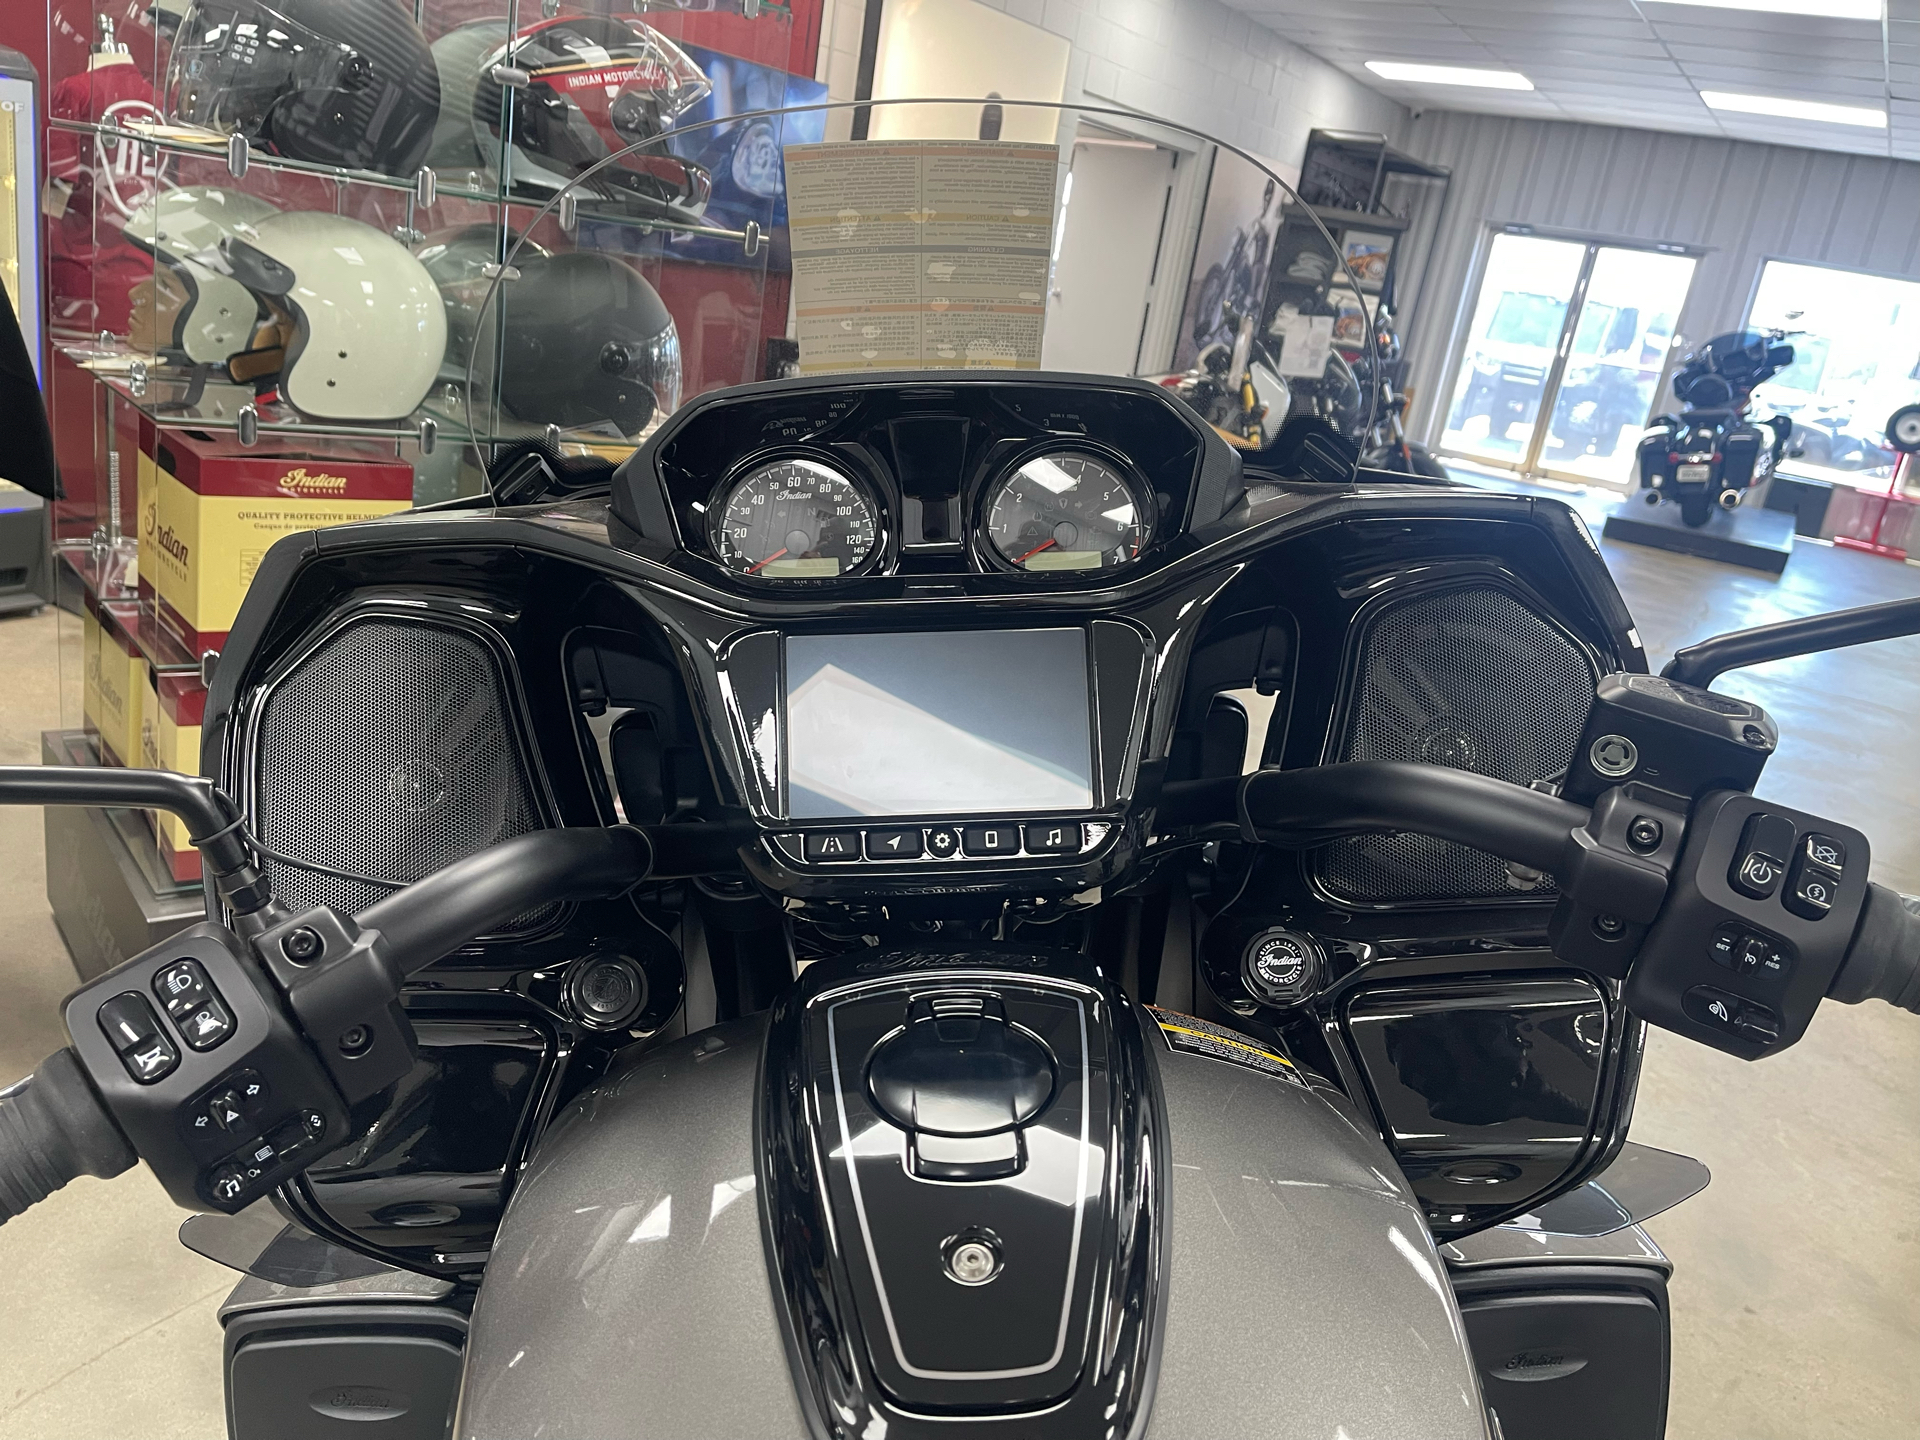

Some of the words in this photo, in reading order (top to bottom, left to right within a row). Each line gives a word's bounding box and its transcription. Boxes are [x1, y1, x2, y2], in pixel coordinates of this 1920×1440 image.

[568, 73, 602, 88] INDIAN
[603, 69, 660, 85] MOTORCY
[1, 101, 24, 113] OF
[279, 468, 347, 488] Indian
[787, 477, 801, 487] 60
[806, 477, 816, 485] 70
[281, 486, 345, 495] MOTORCYCLE
[769, 482, 780, 490] 50
[819, 483, 832, 493] 80
[751, 494, 765, 505] 40
[776, 489, 813, 501] Indian
[833, 494, 842, 502] 90
[1016, 493, 1023, 503] 2
[1103, 492, 1110, 501] 5
[238, 511, 281, 520] QUALITY
[283, 512, 343, 521] PROTECTIVE
[741, 507, 751, 515] 30
[836, 506, 852, 516] 100
[1003, 524, 1008, 533] 1
[1117, 522, 1124, 532] 6
[144, 502, 190, 566] Indian
[734, 528, 748, 539] 20
[846, 535, 862, 545] 120
[734, 550, 743, 559] 10
[853, 546, 865, 554] 140
[1113, 556, 1119, 565] 7
[1259, 940, 1281, 956] SINCE
[1284, 941, 1300, 954] 1901
[1715, 942, 1731, 952] SET
[1257, 953, 1303, 967] Indian
[1764, 960, 1780, 970] RES
[1259, 965, 1303, 984] MOTORCYCLE
[1190, 1030, 1264, 1055] CAUTION
